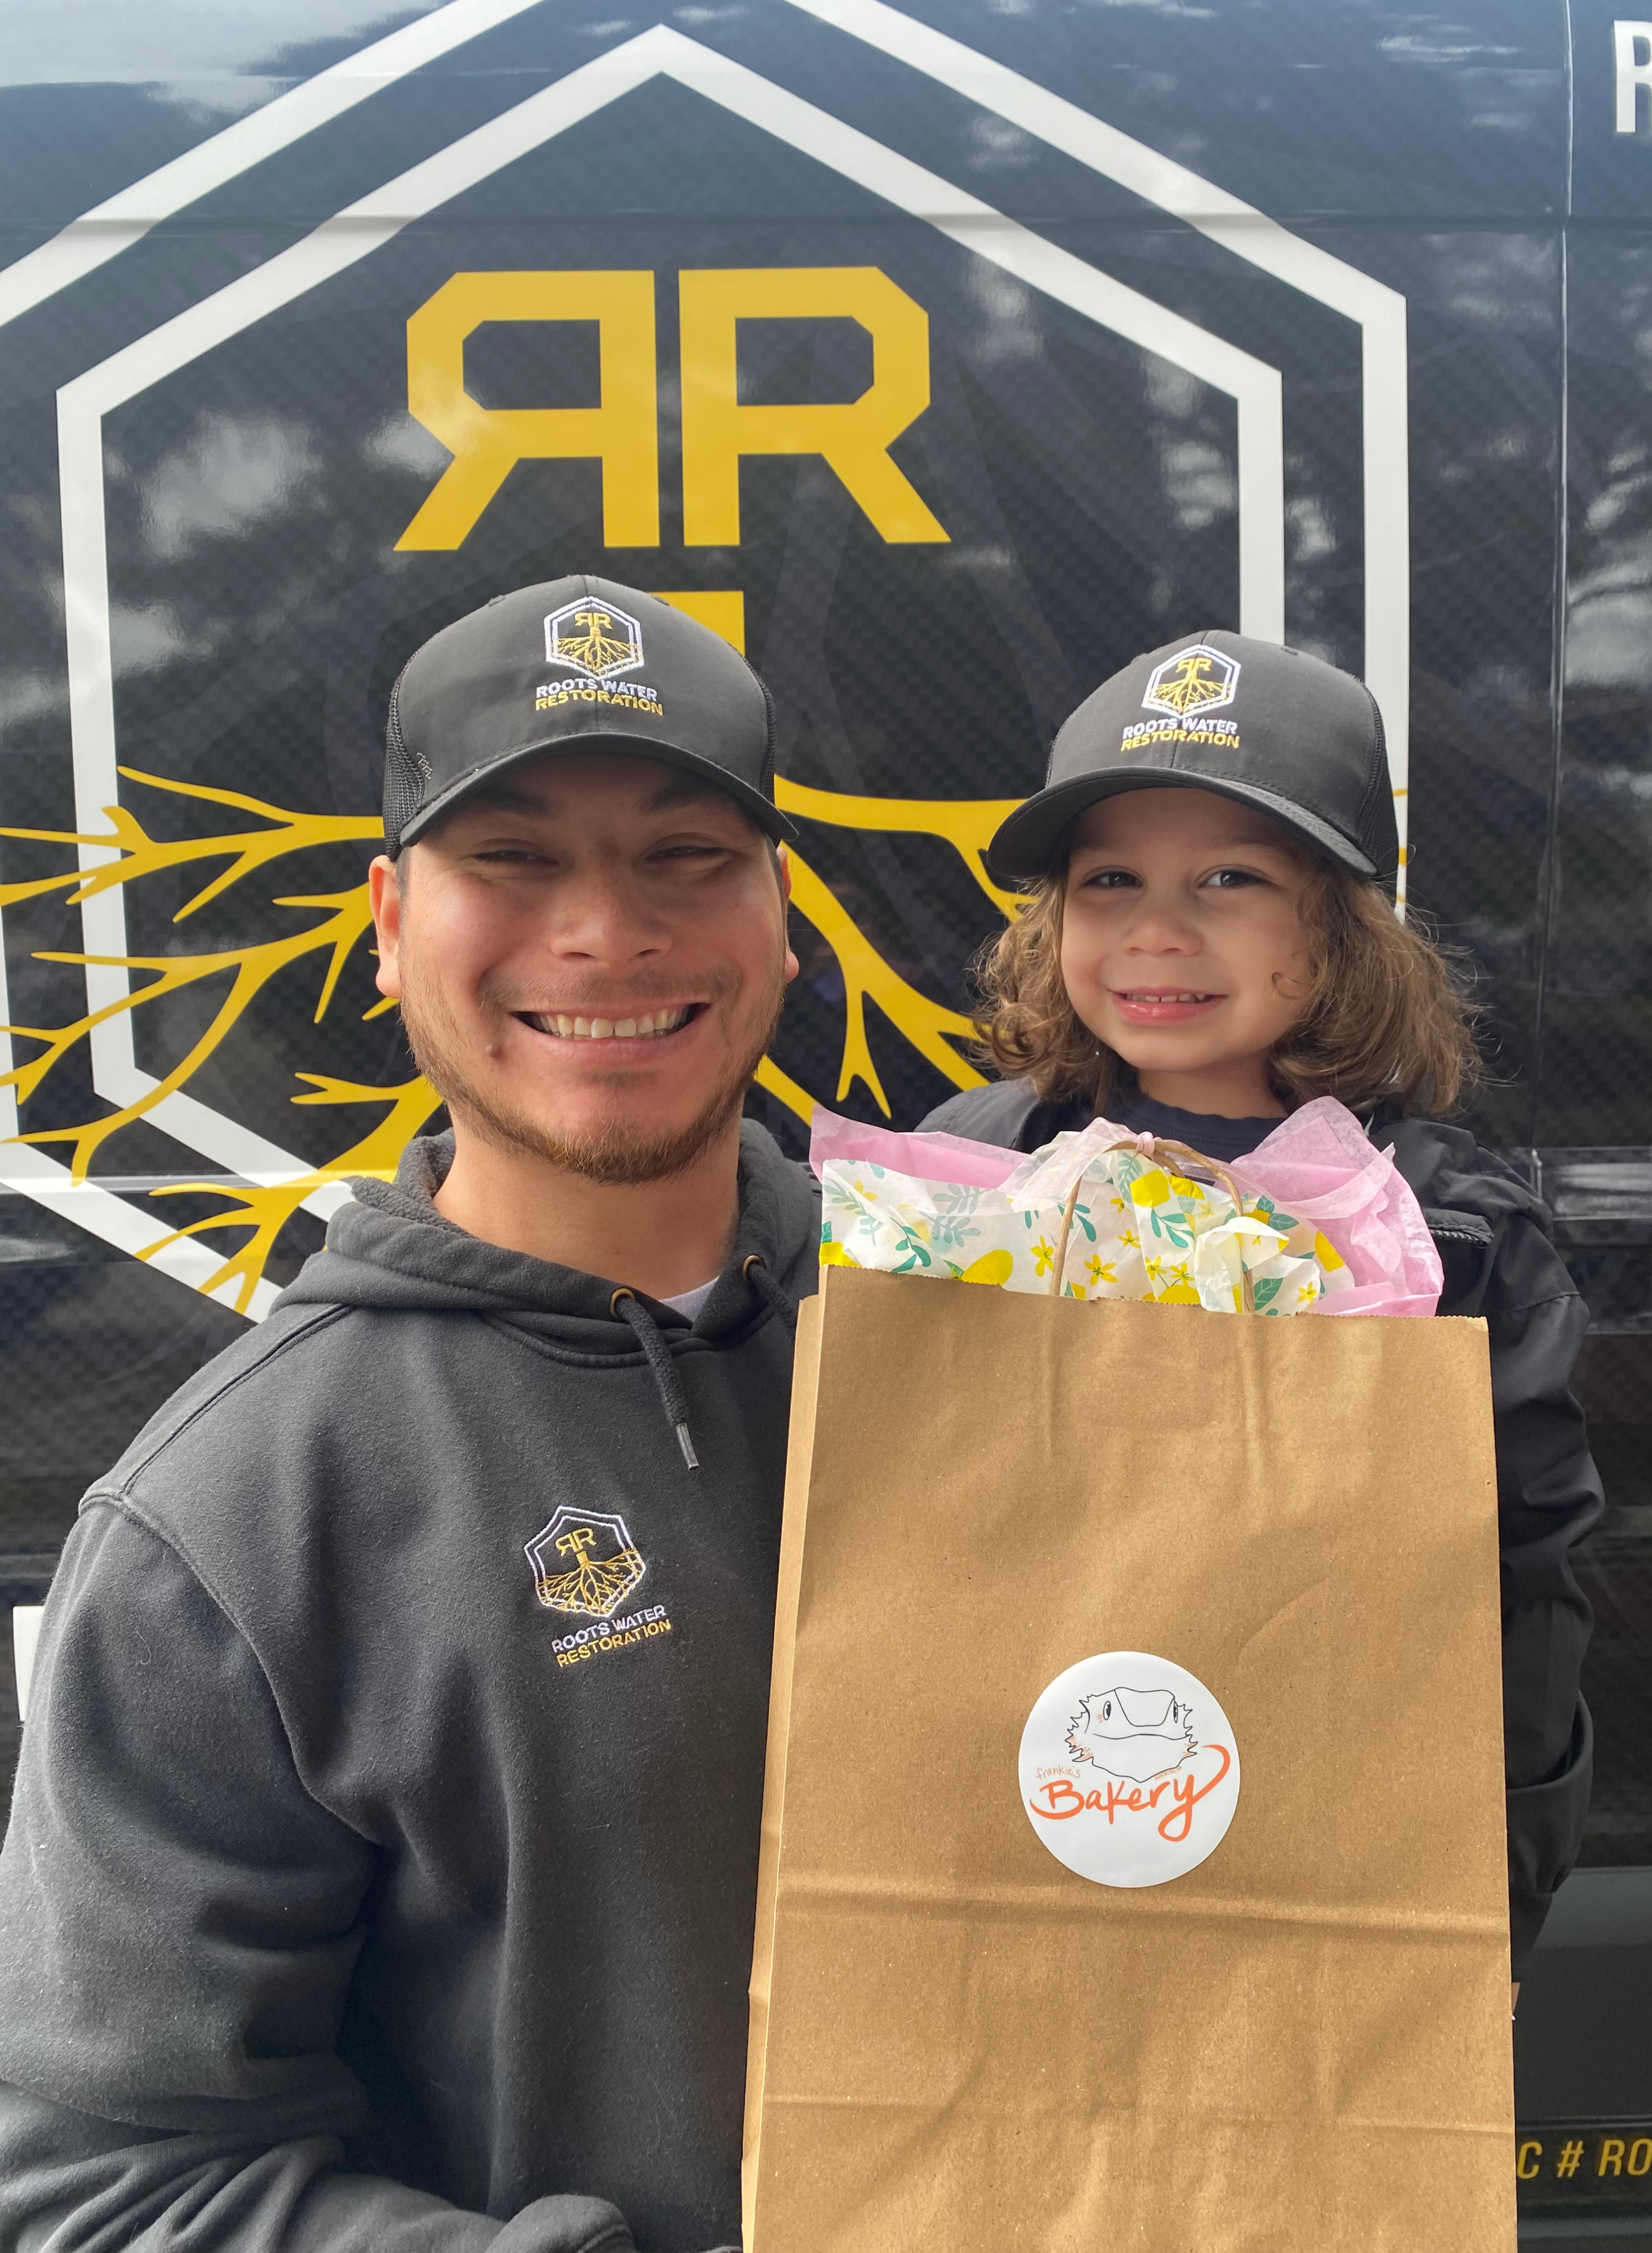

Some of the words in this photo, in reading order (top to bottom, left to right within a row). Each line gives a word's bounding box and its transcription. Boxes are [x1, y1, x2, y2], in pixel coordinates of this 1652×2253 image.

[1613, 20, 1652, 132] R
[536, 678, 598, 698] ROOTS
[600, 679, 658, 701] WATER
[536, 689, 664, 716] RESTORATION
[1120, 729, 1241, 751] RESTORATION
[1123, 718, 1178, 740] ROOTS
[1182, 718, 1238, 734] WATER
[551, 1622, 610, 1653] ROOTS
[611, 1604, 666, 1632] WATER
[556, 1618, 672, 1668] RESTORATION
[1036, 1764, 1081, 1780] frankie's
[1030, 1744, 1231, 1842] Bakery
[1556, 2139, 1584, 2178] #
[1598, 2138, 1652, 2176] RO
